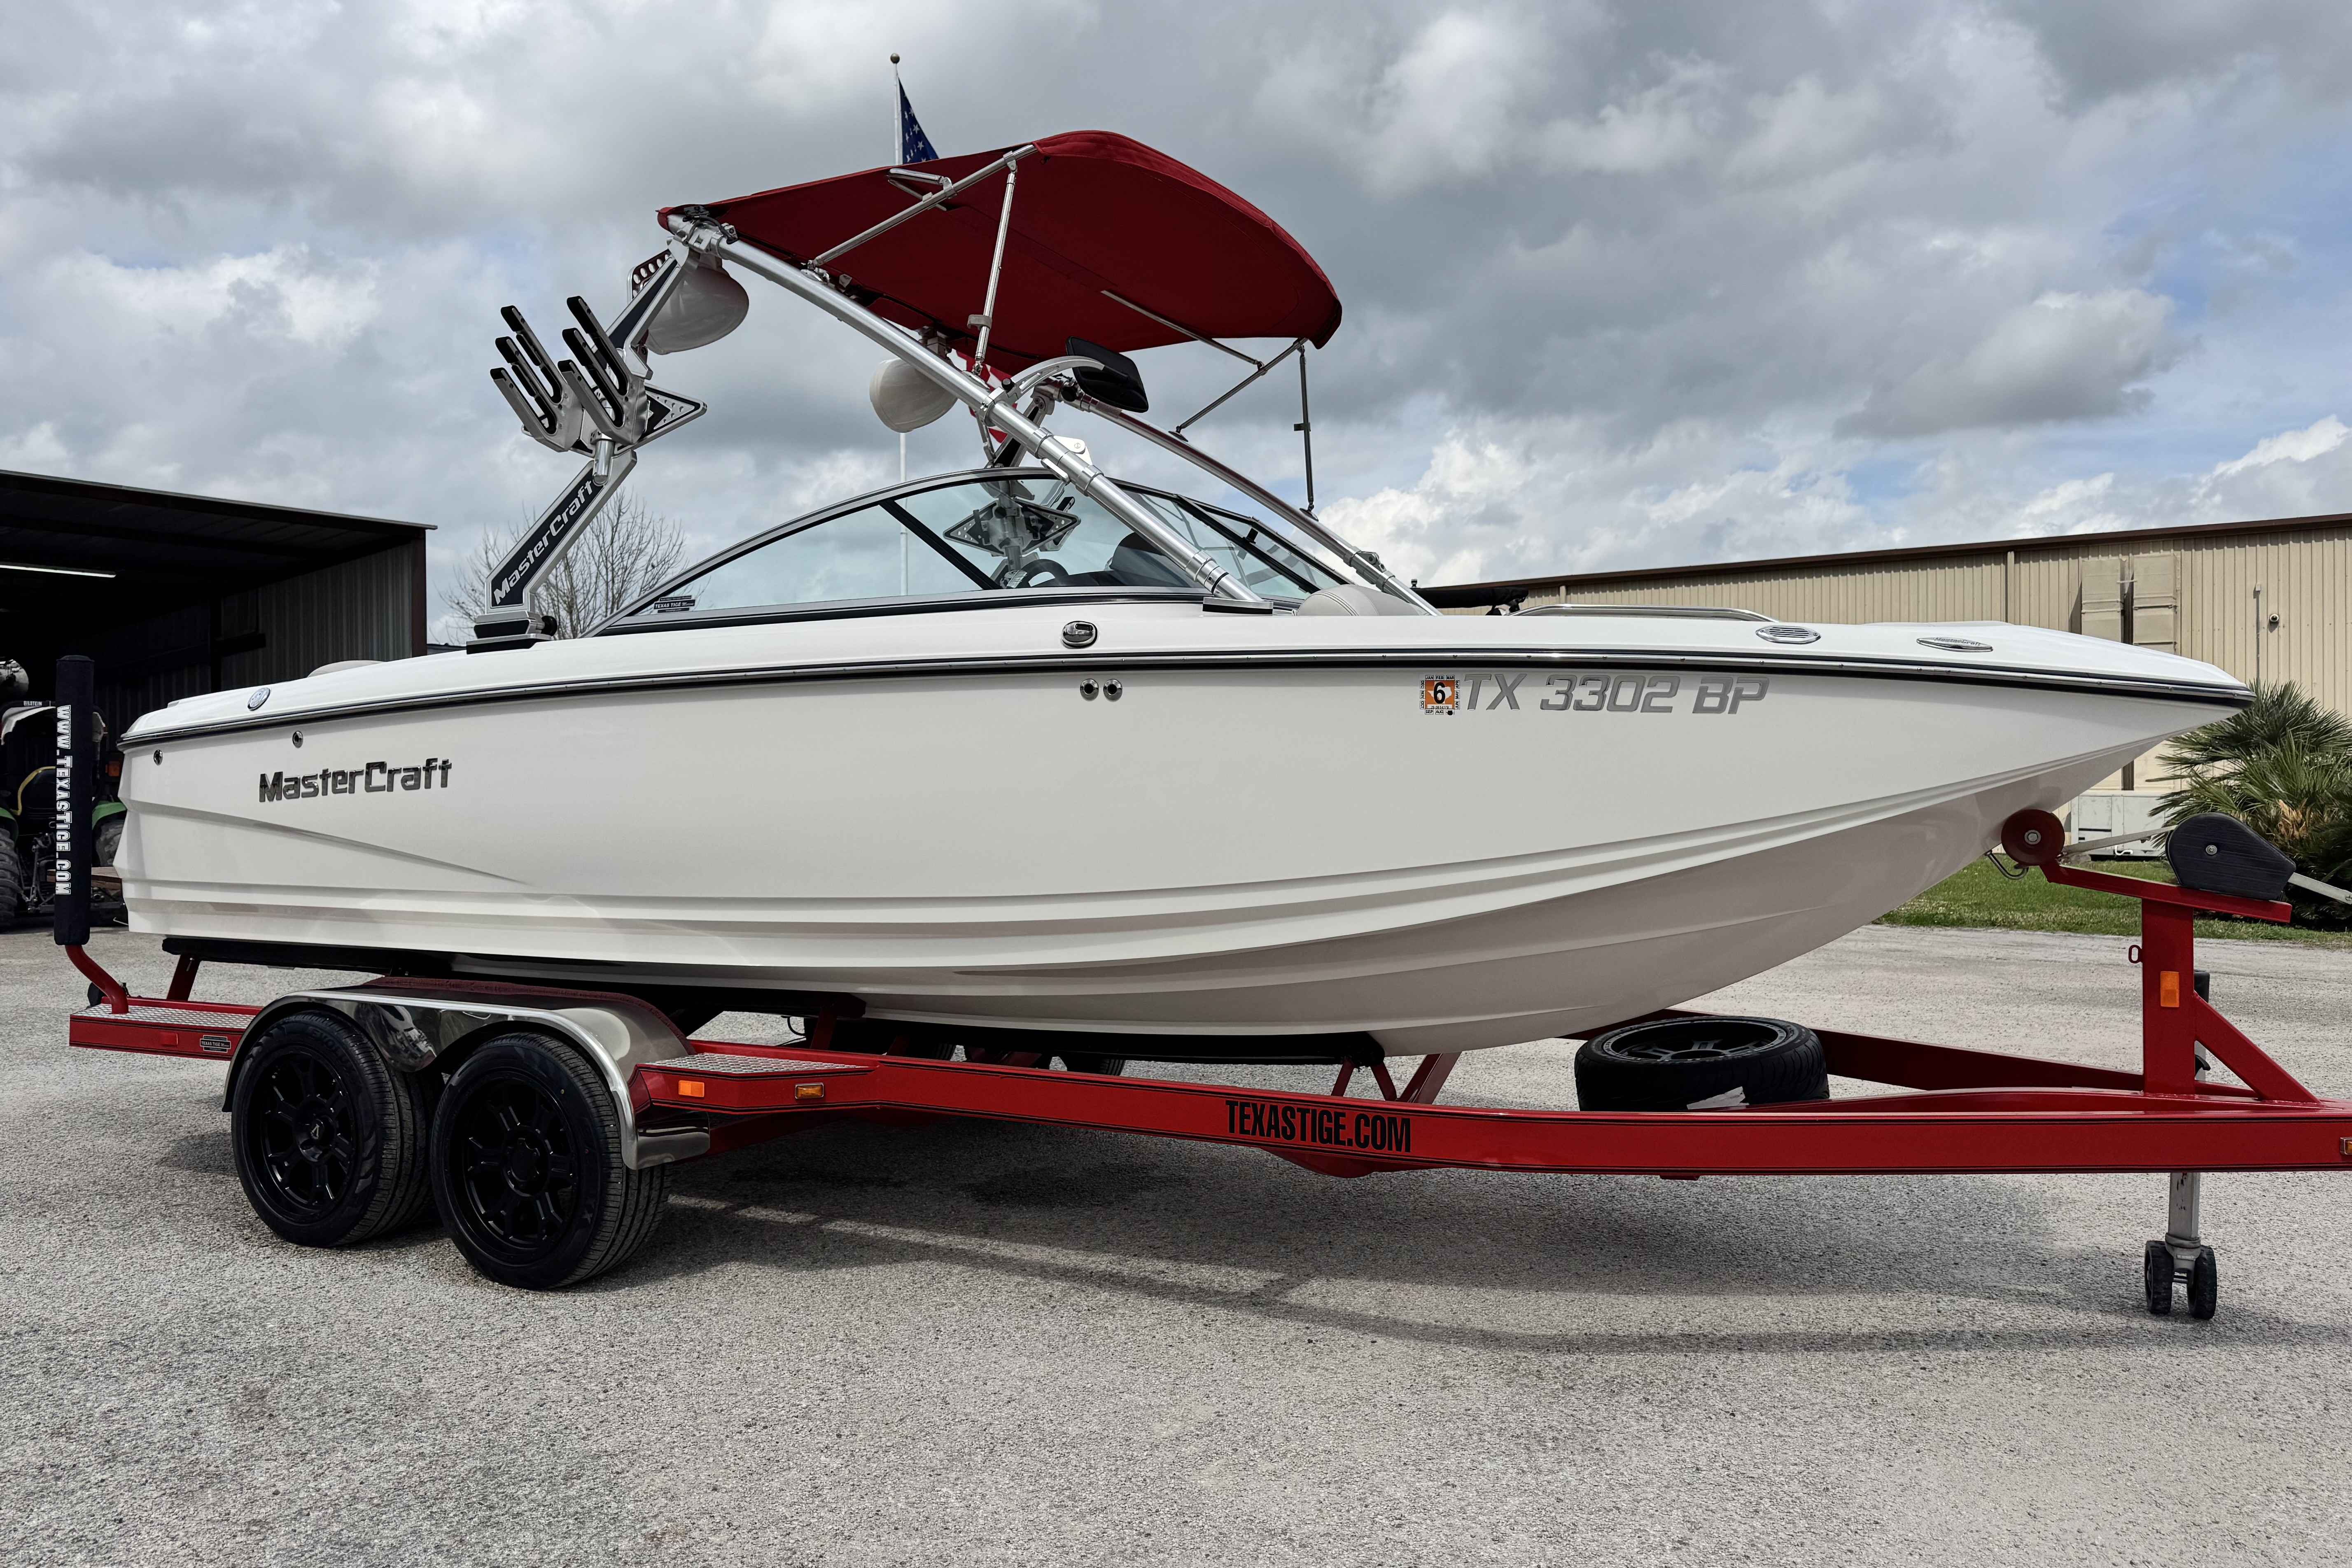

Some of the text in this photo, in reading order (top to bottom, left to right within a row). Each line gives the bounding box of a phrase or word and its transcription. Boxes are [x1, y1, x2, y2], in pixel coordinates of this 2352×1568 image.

[494, 481, 593, 604] MasterCraft
[1934, 637, 1981, 646] MasterCraft
[1434, 682, 1446, 704] 6
[1464, 674, 1769, 714] TX 3302 BP
[56, 705, 72, 895] WWW.TEXASTIGE.COM
[259, 758, 452, 802] MasterCraft
[1225, 1100, 1411, 1153] TEXASTIGE.COM
